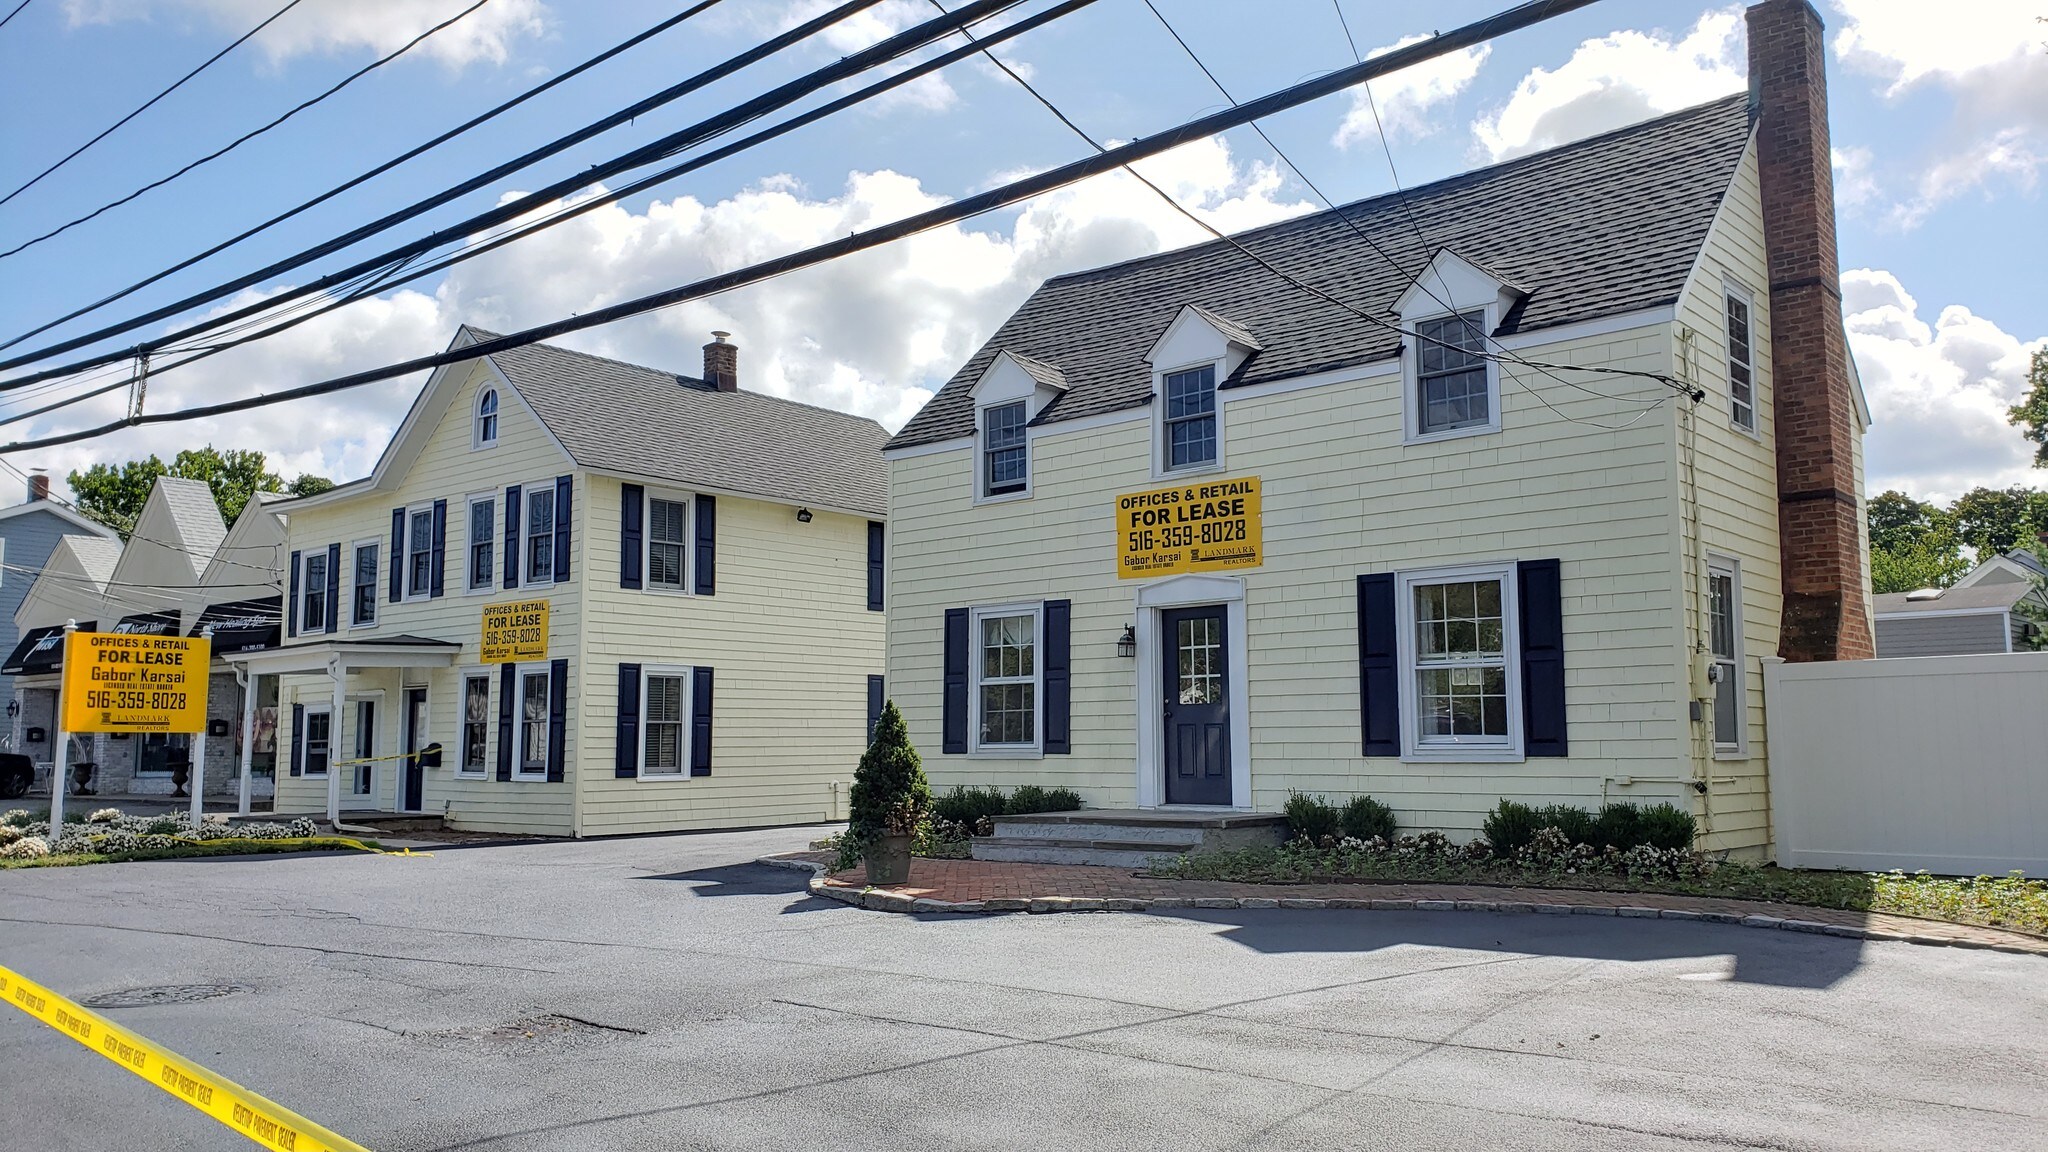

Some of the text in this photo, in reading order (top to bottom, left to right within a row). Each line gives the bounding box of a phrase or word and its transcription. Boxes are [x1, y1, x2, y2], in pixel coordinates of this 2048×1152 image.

[1121, 482, 1253, 509] OFFICES & RETAIL
[1131, 498, 1245, 528] FOR LEASE
[1129, 519, 1246, 552] 516-359-8028
[1124, 551, 1181, 566] Gabor Karsai
[1204, 545, 1255, 557] LANDMARK
[1223, 557, 1256, 566] REALTORS
[484, 602, 545, 616] OFFICES & RETAIL
[488, 613, 541, 629] FOR LEASE
[91, 637, 190, 650] OFFICES & RETAIL
[486, 627, 541, 645] 516-359-8028
[98, 650, 183, 665] FOR LEASE
[92, 666, 185, 683] Gabor Karsai
[87, 690, 186, 710] 516-359-8028
